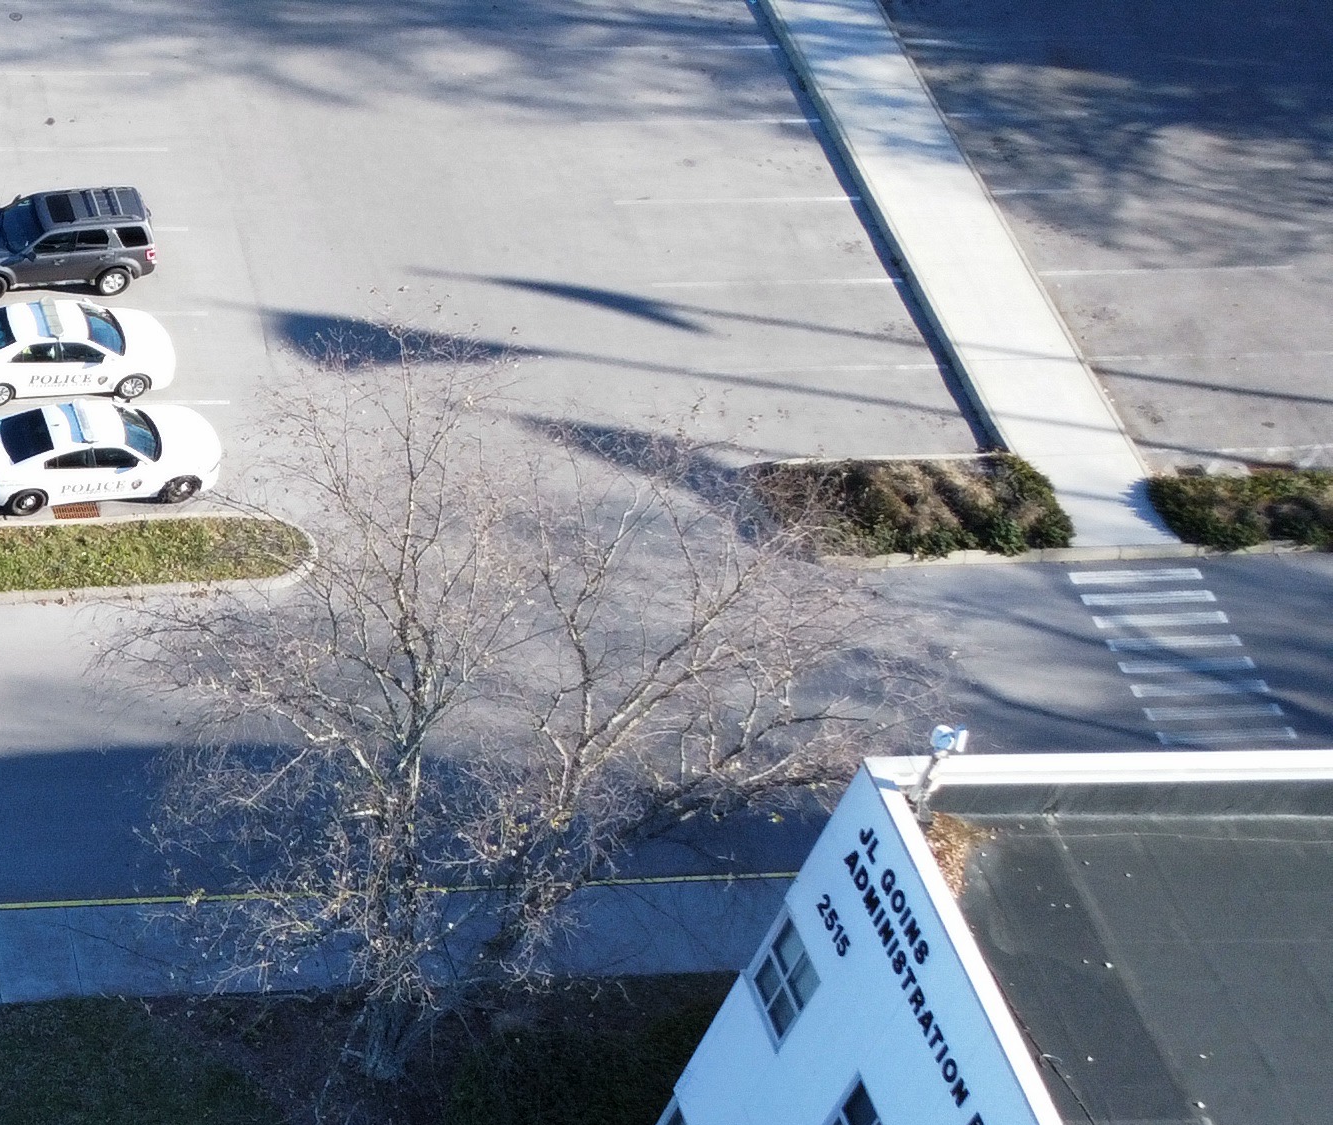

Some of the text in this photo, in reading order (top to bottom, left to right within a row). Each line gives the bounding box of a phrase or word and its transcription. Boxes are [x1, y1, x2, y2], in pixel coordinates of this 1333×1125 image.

[29, 374, 93, 384] POLICE
[61, 480, 126, 493] POLICE
[815, 893, 851, 958] 2515
[859, 828, 930, 965] JL GOINS
[843, 850, 970, 1108] ADMINISTRATION
